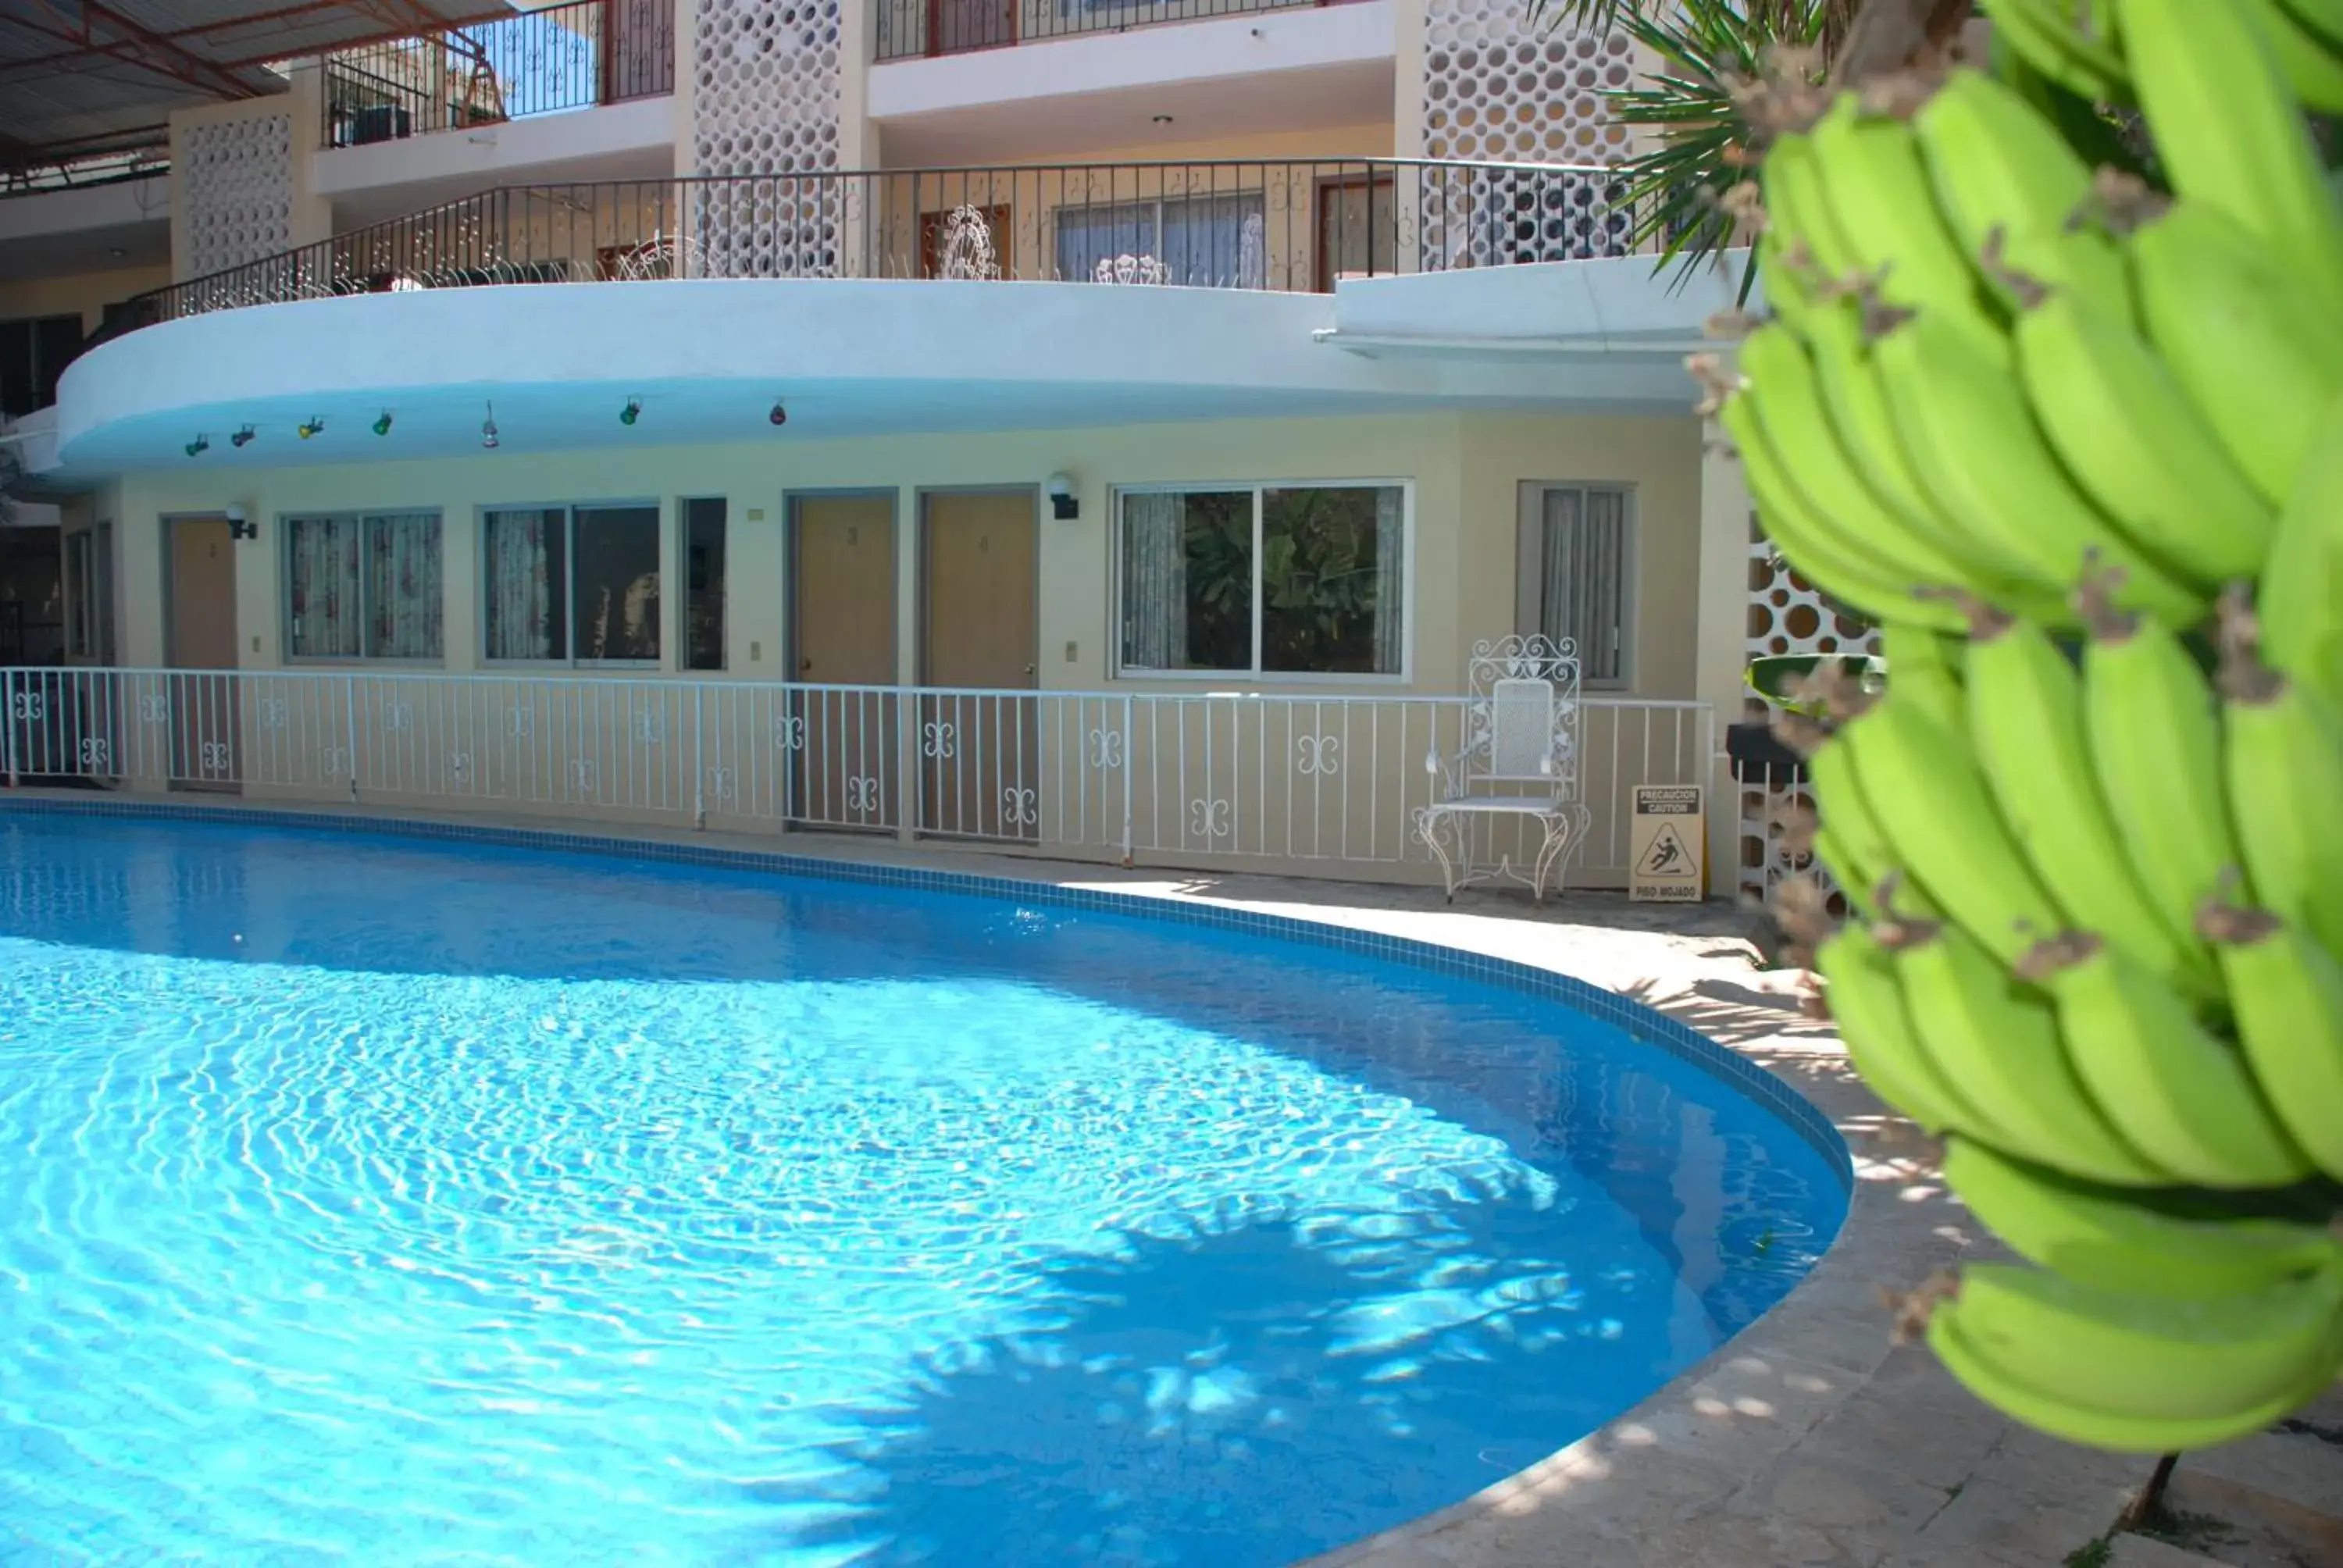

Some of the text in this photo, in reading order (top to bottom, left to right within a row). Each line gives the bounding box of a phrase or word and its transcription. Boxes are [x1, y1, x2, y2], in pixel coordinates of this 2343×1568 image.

[1648, 803, 1689, 813] CAUTION
[1636, 886, 1696, 898] PISO MOJADO
